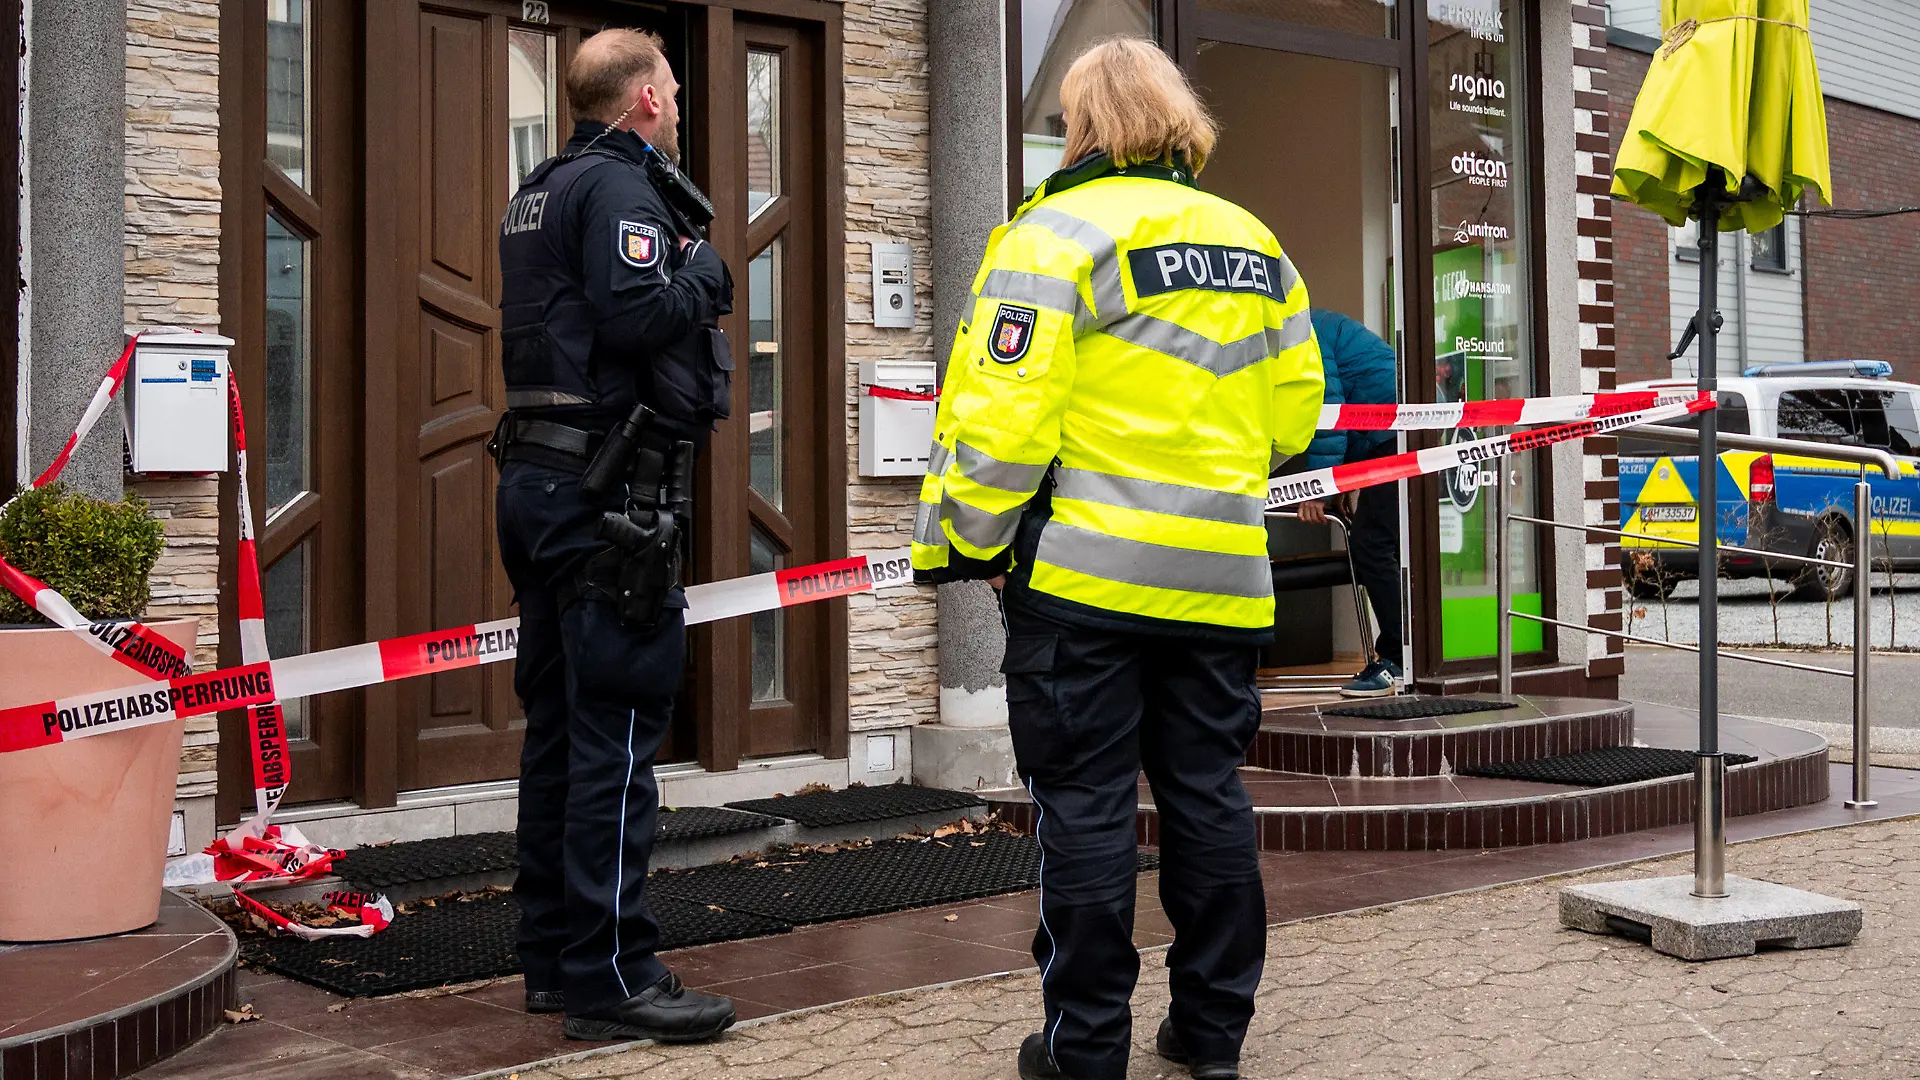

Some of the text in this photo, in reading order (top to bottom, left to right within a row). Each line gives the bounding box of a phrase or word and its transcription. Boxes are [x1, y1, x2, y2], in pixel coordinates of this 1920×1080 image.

[525, 3, 547, 23] 22
[1448, 4, 1503, 29] PHONAK
[1494, 34, 1504, 43] on
[1450, 73, 1505, 101] signia
[1450, 101, 1460, 111] Life
[1462, 103, 1483, 114] sounds
[1451, 151, 1507, 178] oticon
[1469, 176, 1507, 188] PEOPLE FIRST
[502, 191, 549, 236] OLIZEI
[623, 224, 656, 238] POLIZEI
[1155, 248, 1273, 294] POLIZEI
[1470, 281, 1511, 295] HANSATON
[1000, 309, 1034, 324] POLIZEI
[1455, 336, 1504, 353] ReSound
[1619, 465, 1647, 474] OLIZEI
[1870, 496, 1911, 515] OLIZEI
[427, 627, 520, 664] POLIZEIA
[42, 671, 271, 737] POLIZEIABSPERRUNG
